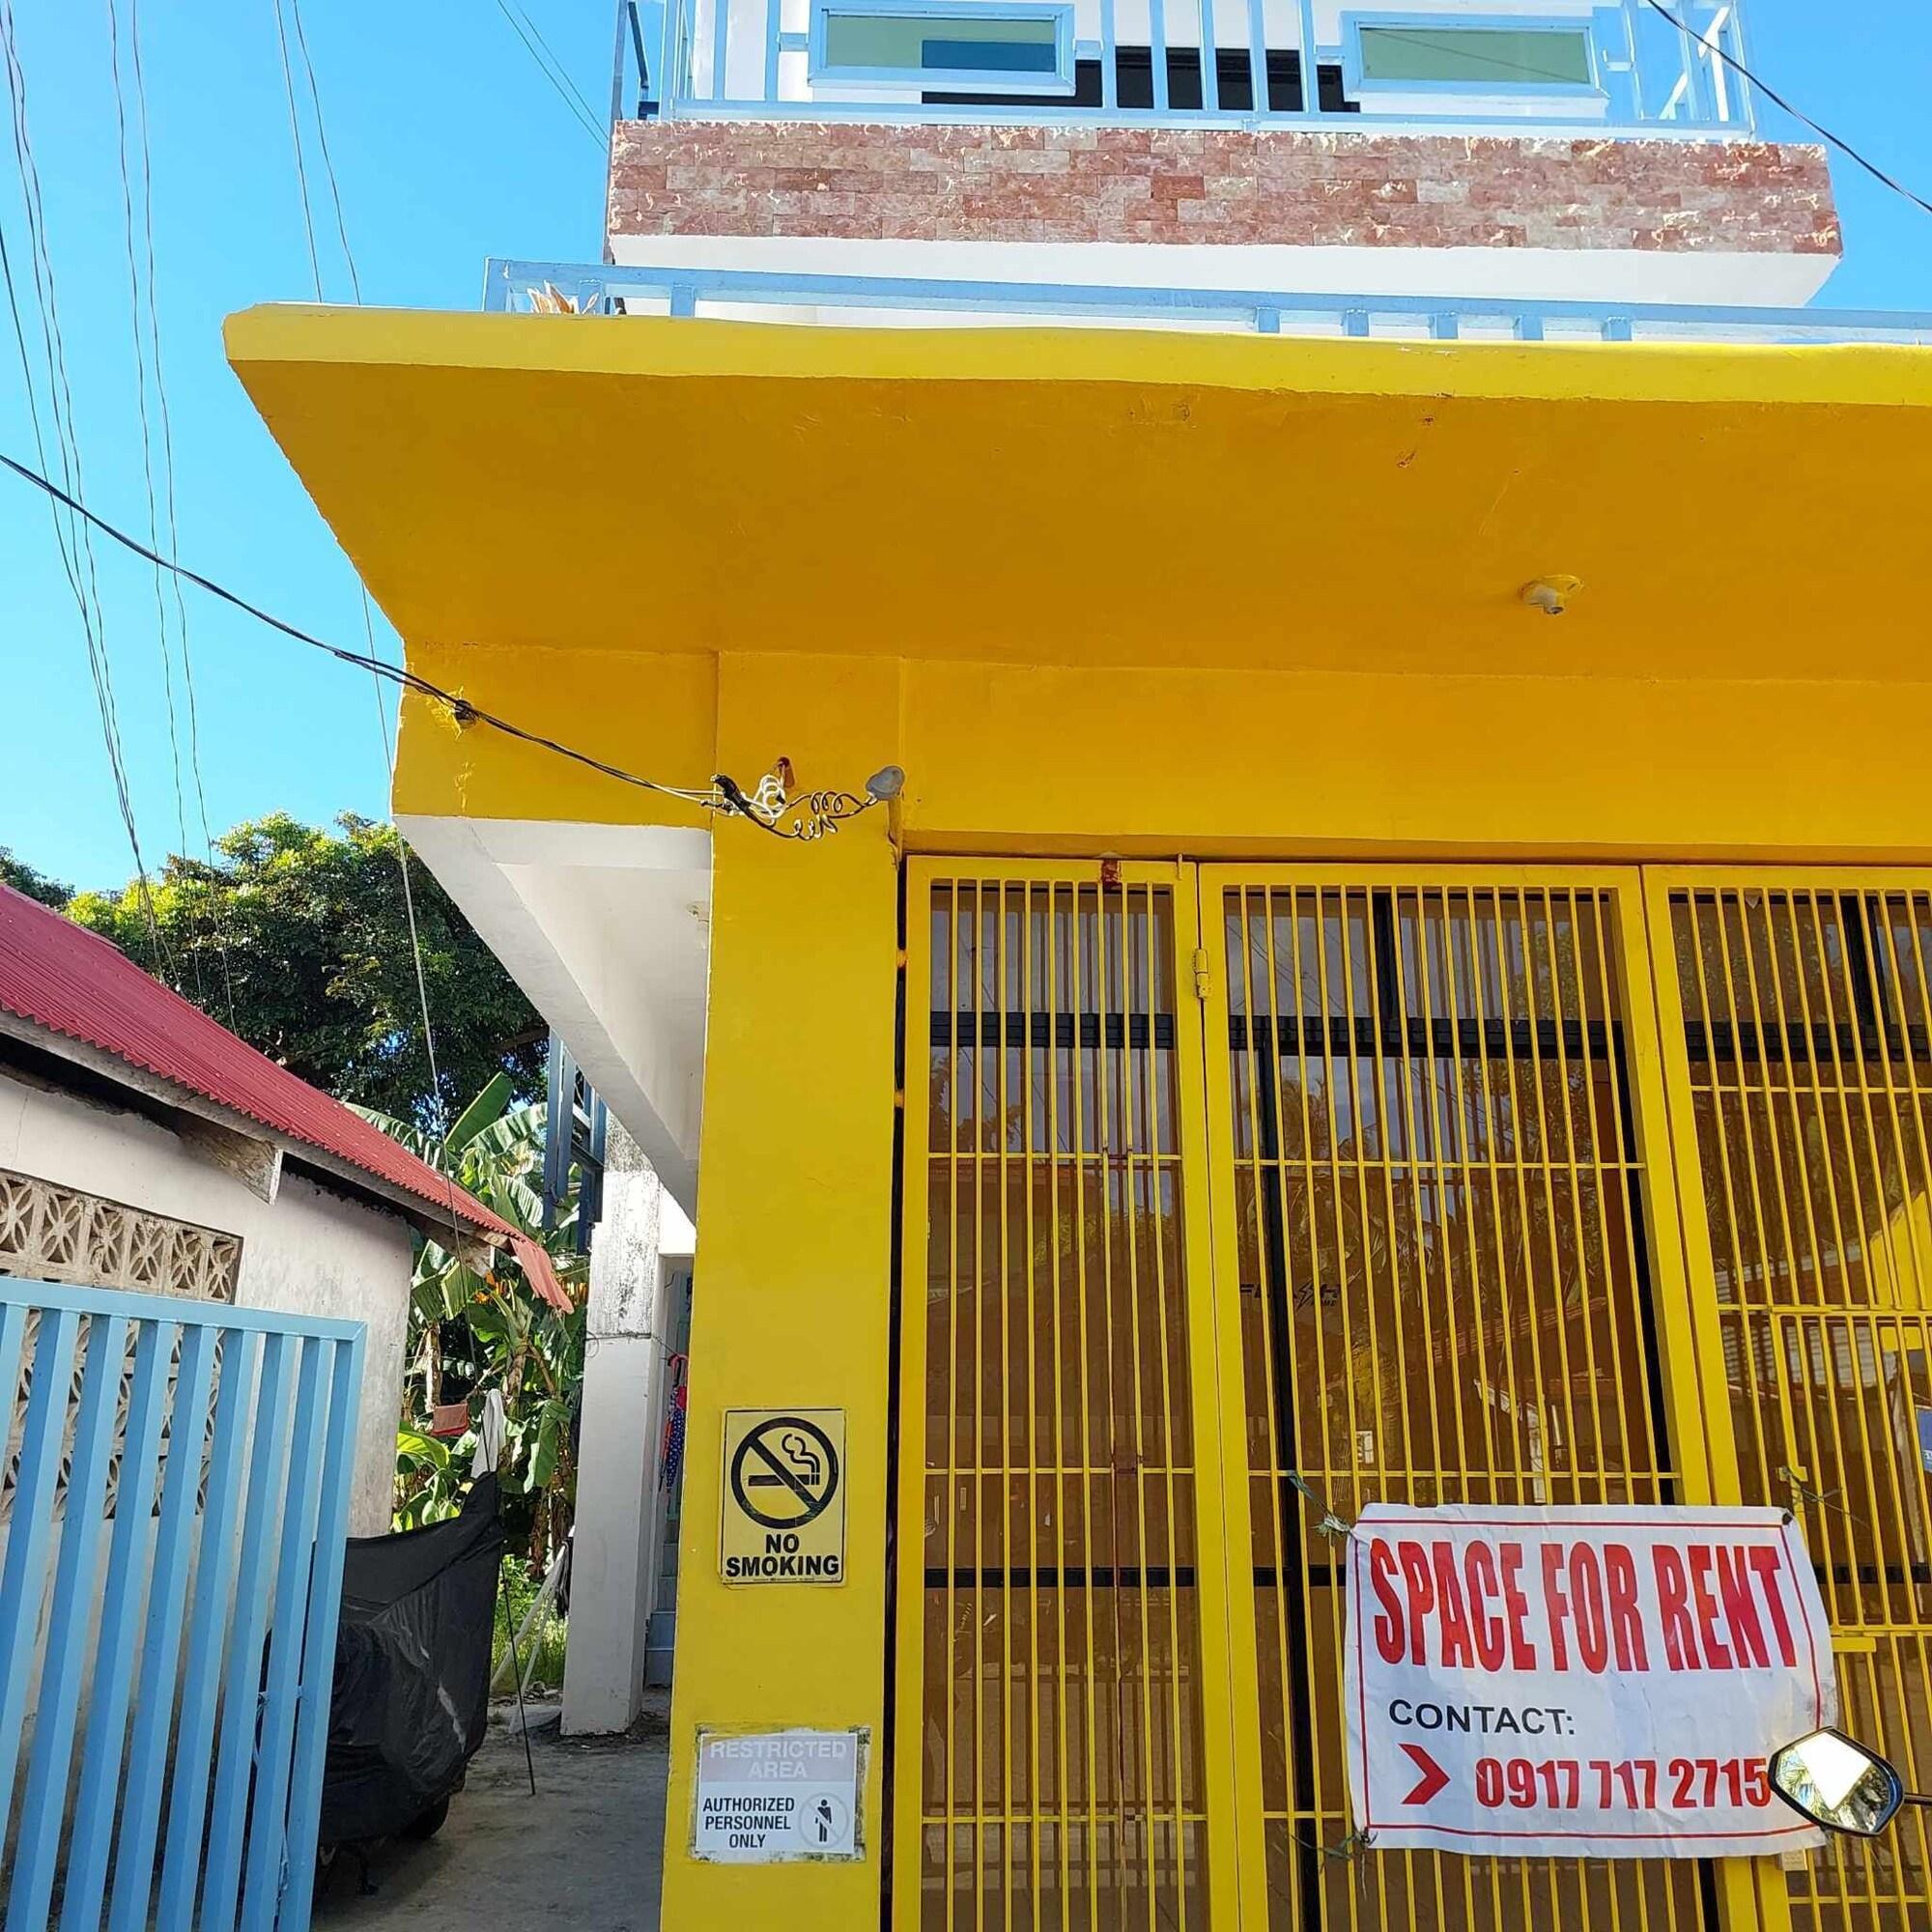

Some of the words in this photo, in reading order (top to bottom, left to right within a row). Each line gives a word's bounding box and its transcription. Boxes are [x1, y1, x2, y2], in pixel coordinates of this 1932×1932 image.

[765, 1534, 800, 1554] NO
[726, 1555, 839, 1577] SMOKING
[1370, 1538, 1537, 1672] SPACE
[1540, 1541, 1649, 1673] FOR
[1652, 1544, 1797, 1670] RENT
[1389, 1699, 1575, 1735] CONTACT:
[711, 1743, 846, 1759] RESTRICTED
[749, 1763, 808, 1778] AREA
[1475, 1758, 1579, 1809] 0917
[1589, 1760, 1657, 1809] 717
[1668, 1758, 1772, 1808] 2715
[703, 1797, 795, 1812] AUTHORIZED
[705, 1815, 791, 1831] PERSONNEL
[728, 1833, 766, 1849] ONLY
